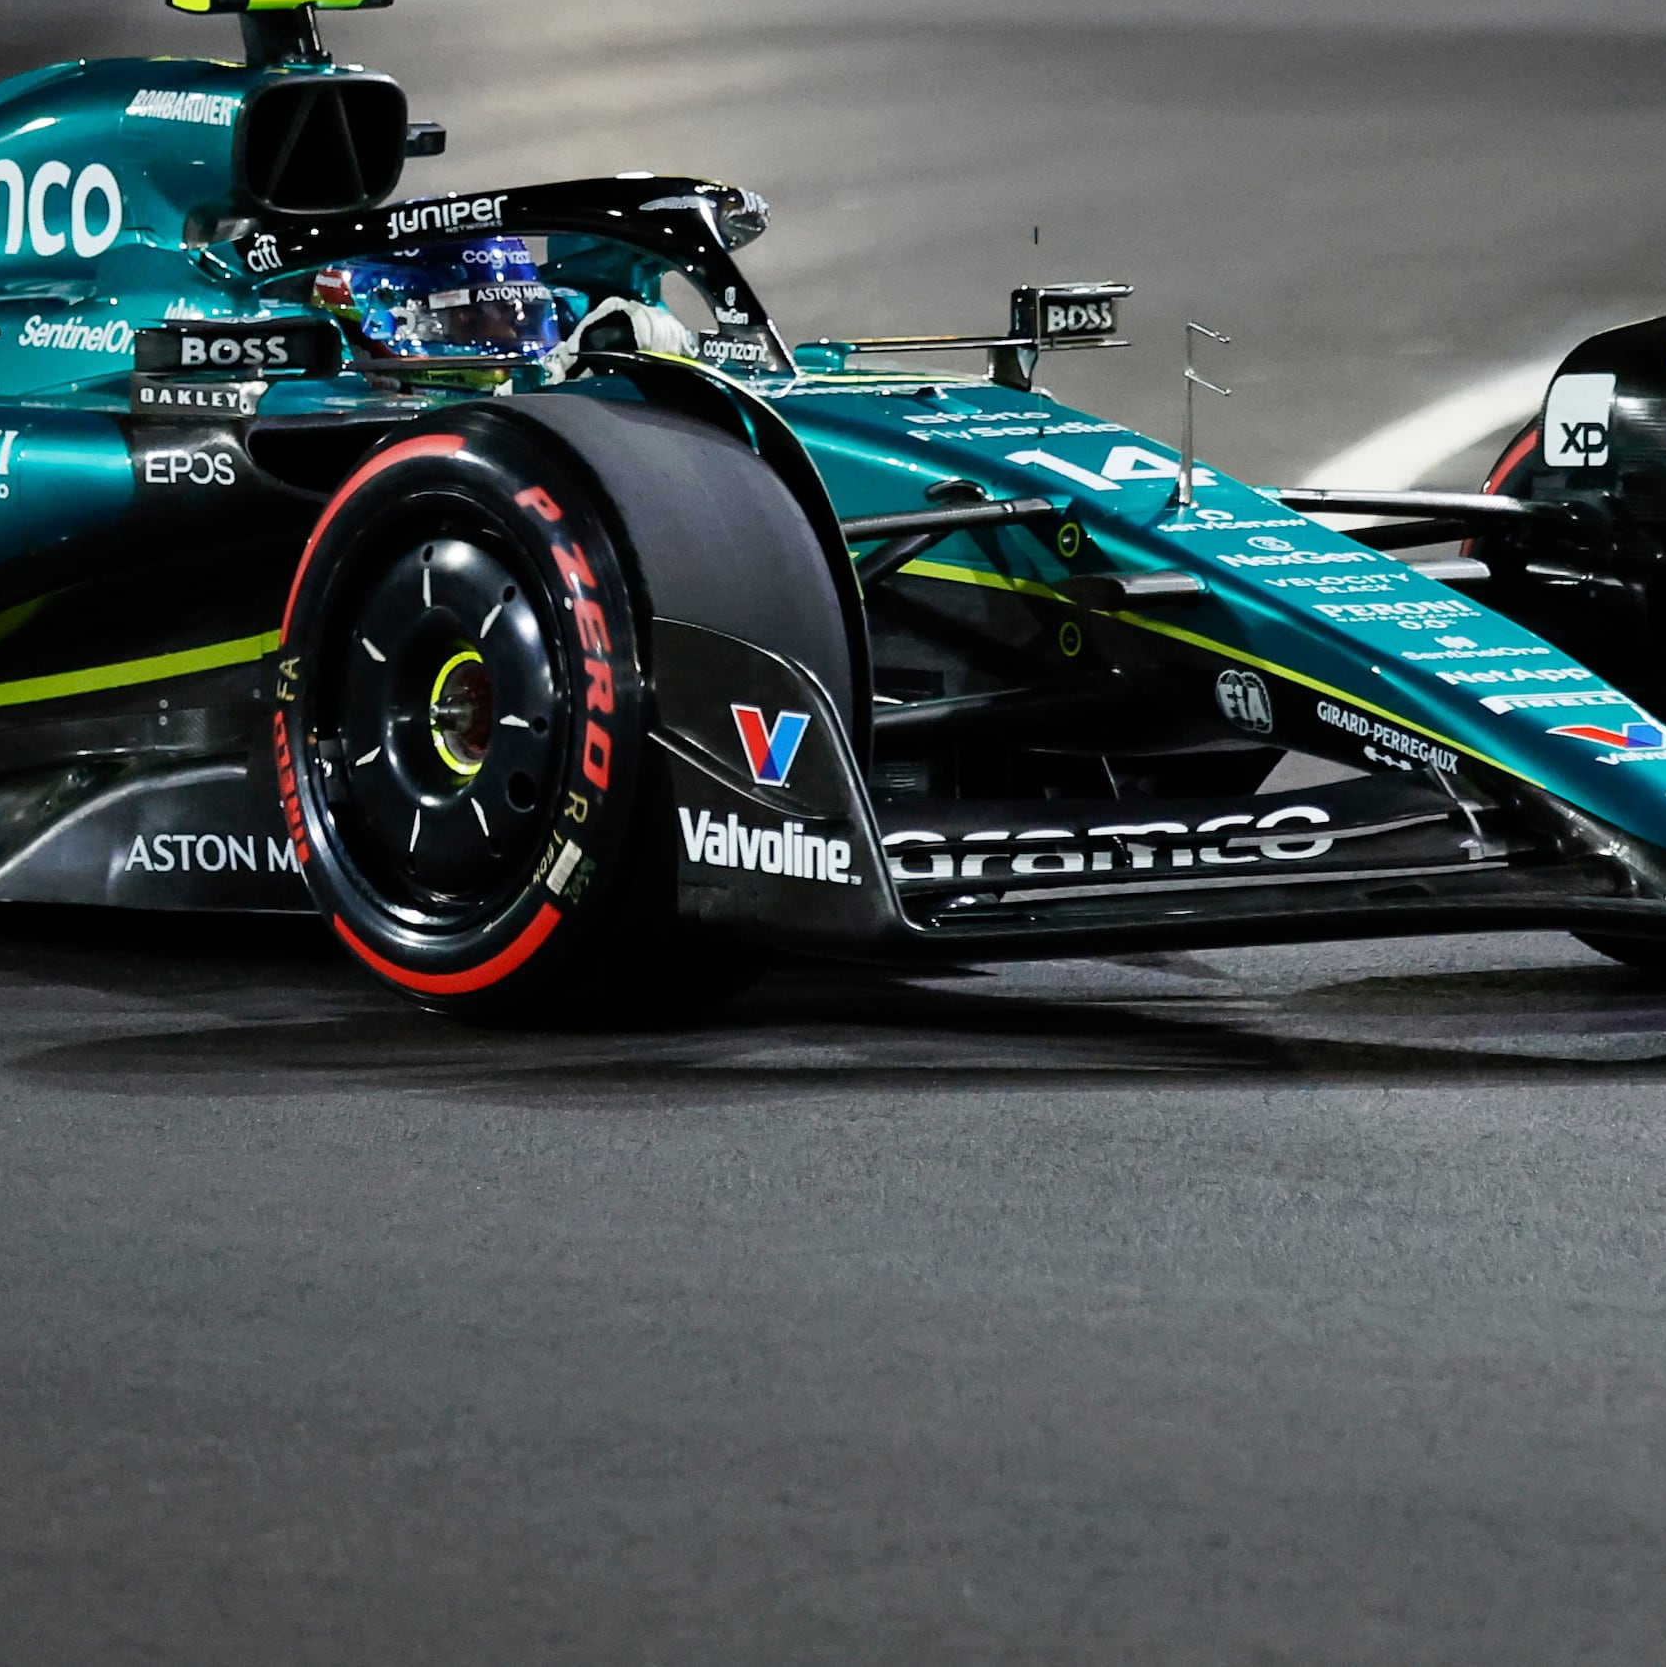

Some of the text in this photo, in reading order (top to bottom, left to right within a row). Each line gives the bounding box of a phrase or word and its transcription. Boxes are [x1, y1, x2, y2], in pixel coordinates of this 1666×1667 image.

[126, 89, 233, 126] BOMBARDIER
[247, 233, 283, 272] citi
[476, 286, 522, 303] ASTON
[1047, 303, 1112, 332] BOSS
[18, 315, 134, 356] SentinelOn
[181, 337, 289, 366] BOSS
[704, 338, 769, 364] cognizant
[140, 388, 238, 409] OAKLEY
[145, 451, 235, 485] EPOS
[1005, 445, 1221, 491] 14
[1216, 550, 1378, 567] NexGen
[1264, 573, 1410, 588] VELOCITY
[1315, 584, 1396, 594] BLACK
[1312, 599, 1473, 619] PERONI
[513, 486, 564, 523] P
[551, 544, 611, 791] ZERO
[1401, 647, 1551, 661] SentinelOne
[1435, 667, 1593, 685] NetApp
[1317, 701, 1459, 775] GIRARD-PERREGAUX
[125, 834, 257, 872] ASTON
[678, 806, 851, 884] Valvoline
[880, 805, 1333, 880] aramco
